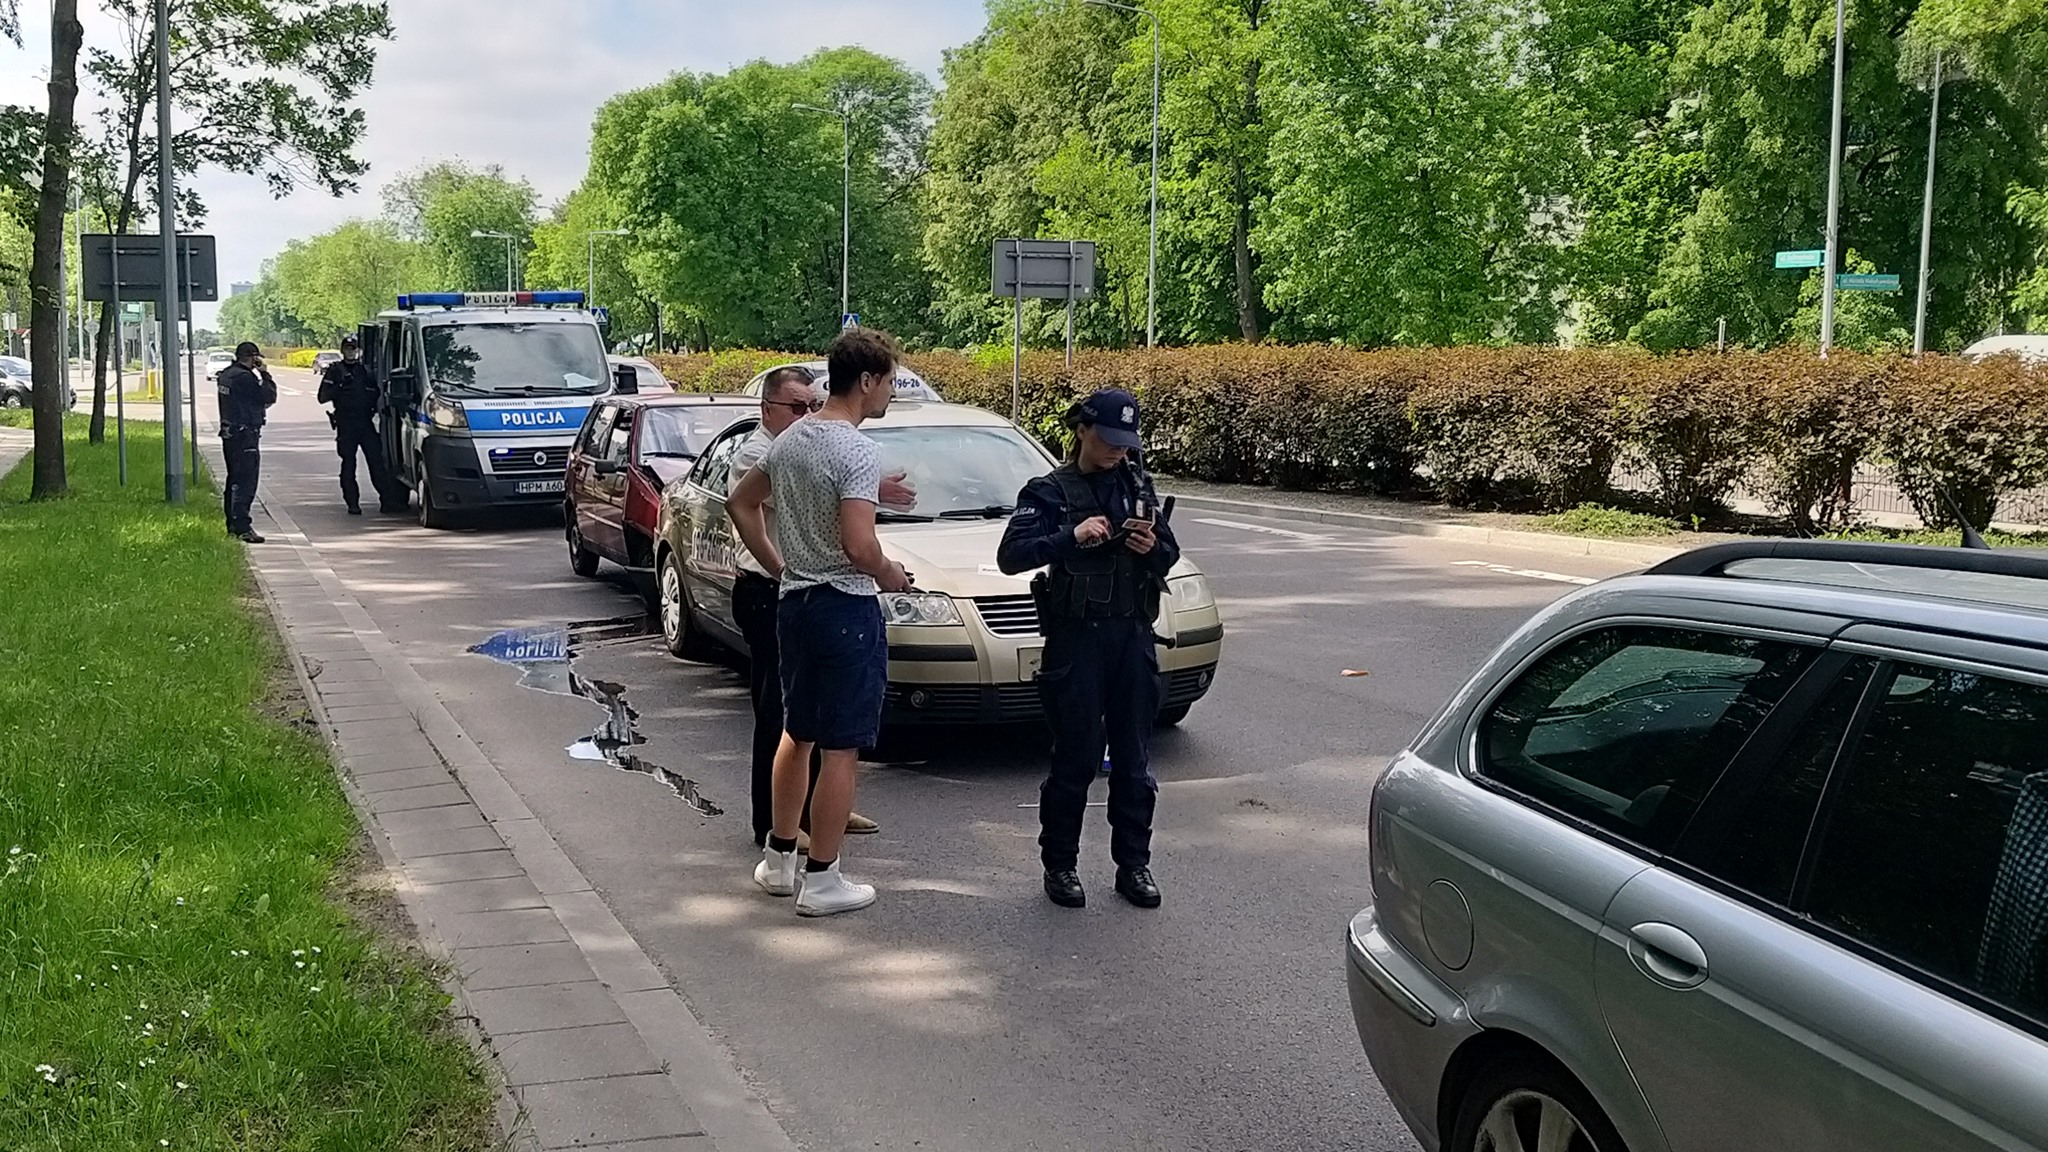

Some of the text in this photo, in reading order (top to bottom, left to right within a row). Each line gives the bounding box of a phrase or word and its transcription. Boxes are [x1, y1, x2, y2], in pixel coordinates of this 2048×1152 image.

[465, 294, 516, 304] POLICJA
[501, 411, 565, 426] POLICJA
[521, 482, 543, 492] HPM
